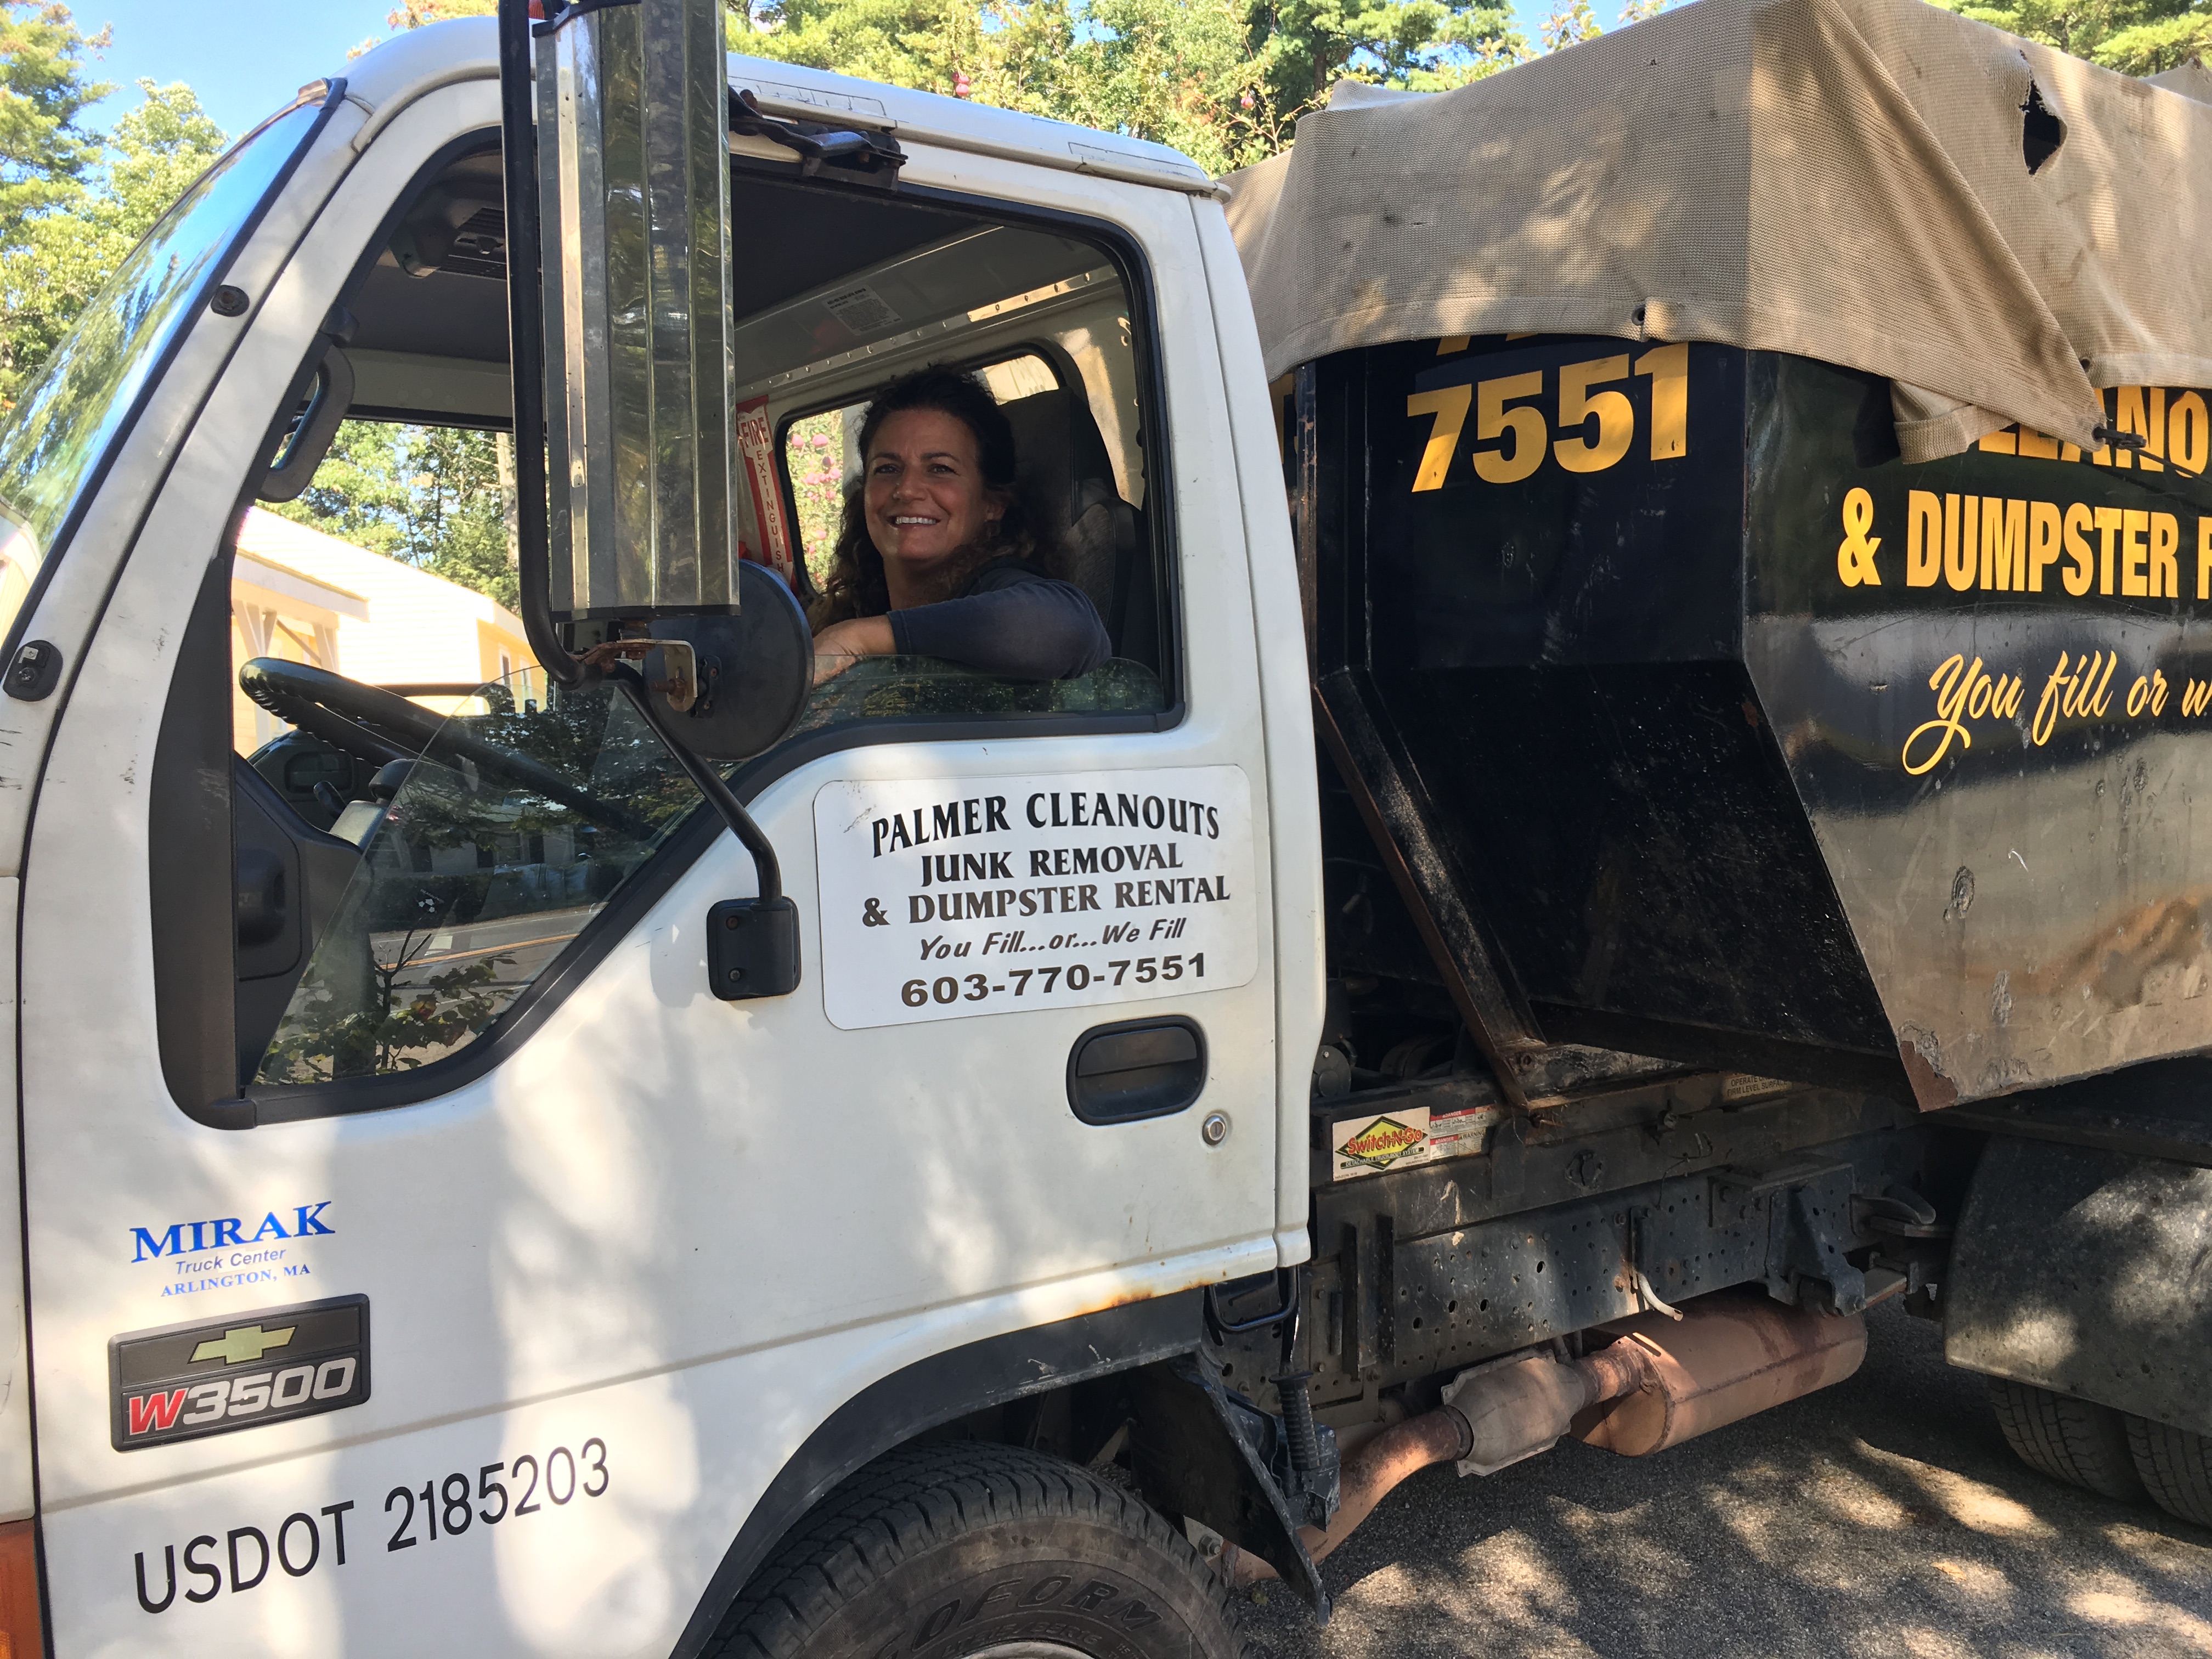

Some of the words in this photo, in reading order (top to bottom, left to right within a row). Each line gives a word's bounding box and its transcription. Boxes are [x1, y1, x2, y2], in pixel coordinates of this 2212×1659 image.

[741, 417, 769, 448] FIRE
[1407, 341, 1689, 493] 7551
[1837, 487, 1882, 588] &
[1906, 490, 2180, 599] DUMPSTER
[1903, 653, 2024, 775] You
[2032, 650, 2118, 747] fill
[2126, 669, 2169, 718] or
[872, 795, 1012, 859] PALMER
[1026, 792, 1221, 840] CLEANOUTS
[921, 851, 1014, 887] JUNK
[1030, 842, 1183, 878] REMOVAL
[862, 897, 890, 928] &
[908, 884, 1103, 924] DUMPSTER
[1114, 876, 1231, 909] RENTAL
[920, 935, 972, 961] You
[1149, 917, 1187, 940] Fill
[900, 952, 1206, 1007] 603-770-7551
[1727, 1087, 1741, 1097] FIRM
[1742, 1085, 1760, 1093] LEVEL
[1731, 1076, 1758, 1086] OPERATE
[129, 1200, 336, 1263] MIRAK
[160, 1268, 278, 1297] ARLINGTON,
[283, 1263, 311, 1277] MA
[175, 1256, 223, 1275] Truck
[229, 1248, 287, 1267] Center
[128, 1357, 357, 1436] W3500
[134, 1500, 354, 1615] USDOT
[384, 1437, 610, 1553] 2185203
